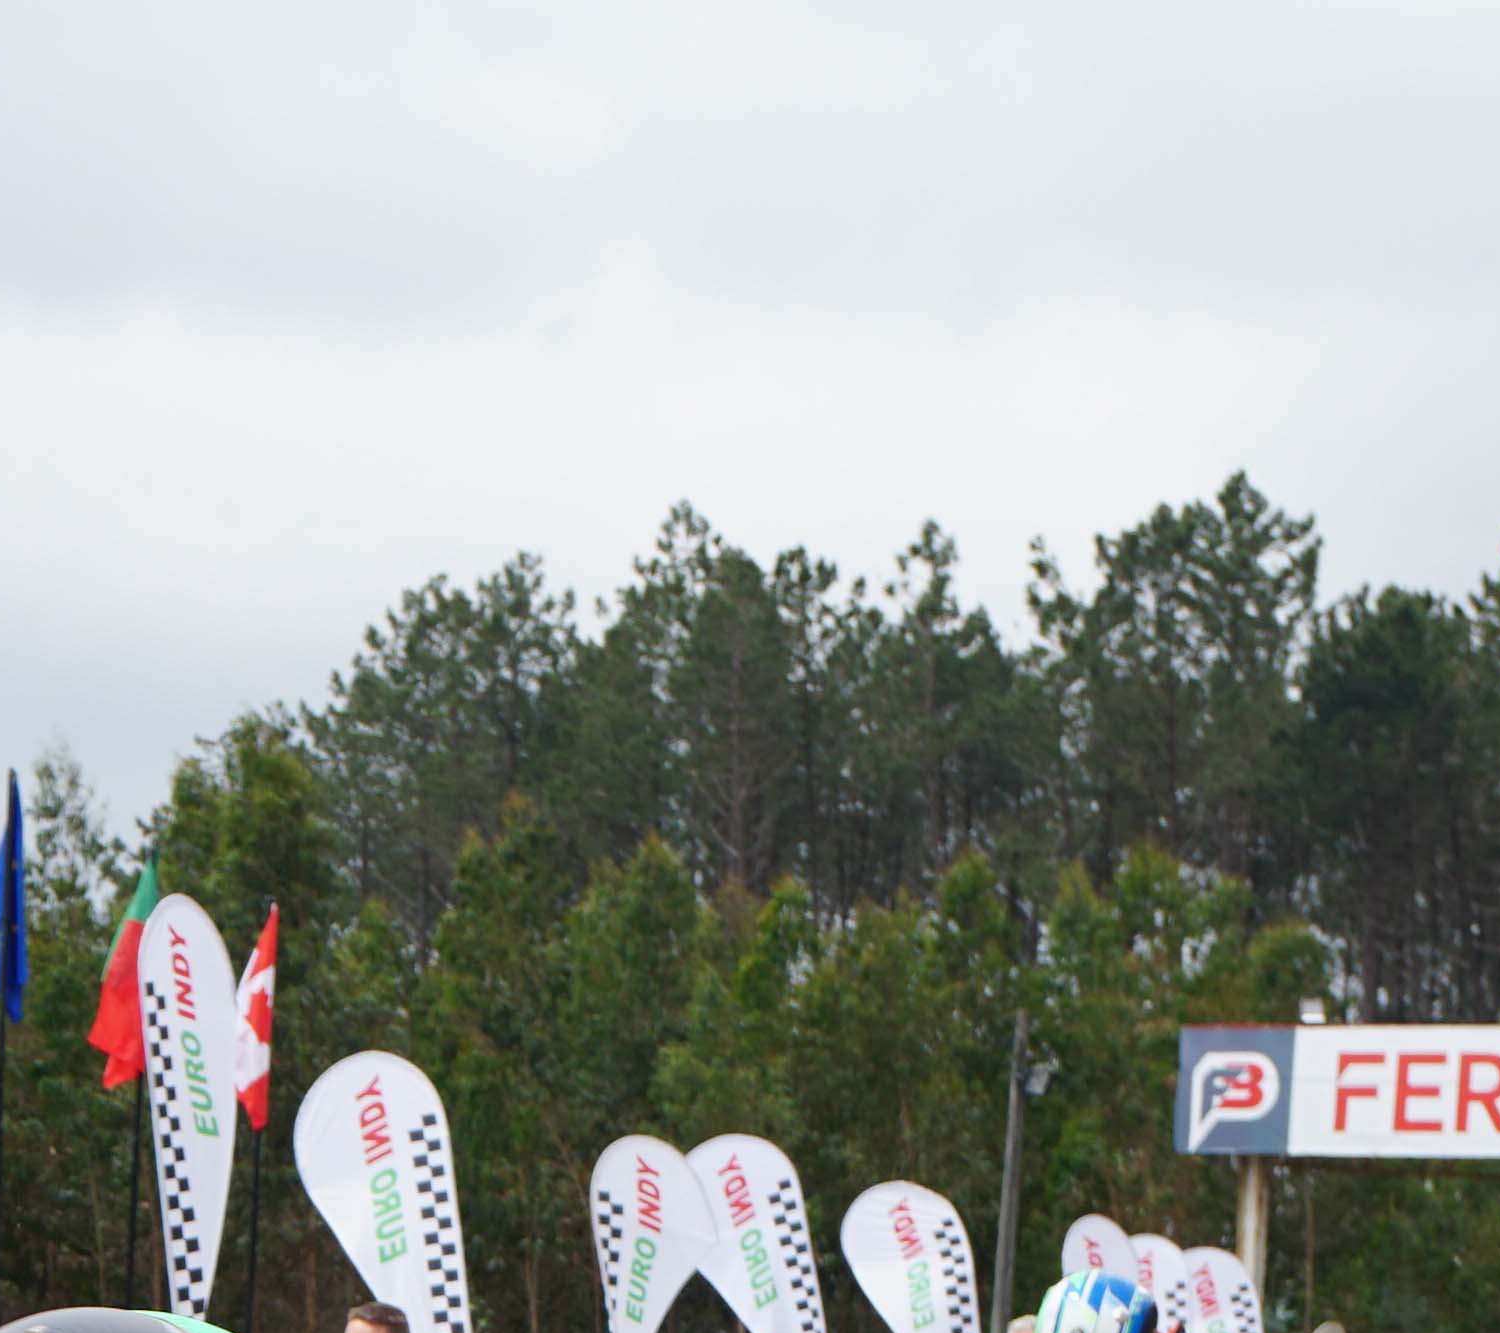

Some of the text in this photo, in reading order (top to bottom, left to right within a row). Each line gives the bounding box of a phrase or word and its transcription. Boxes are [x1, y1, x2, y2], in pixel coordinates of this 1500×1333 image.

[168, 923, 221, 1139] EURO INDY
[625, 1154, 664, 1325] EURO INDY
